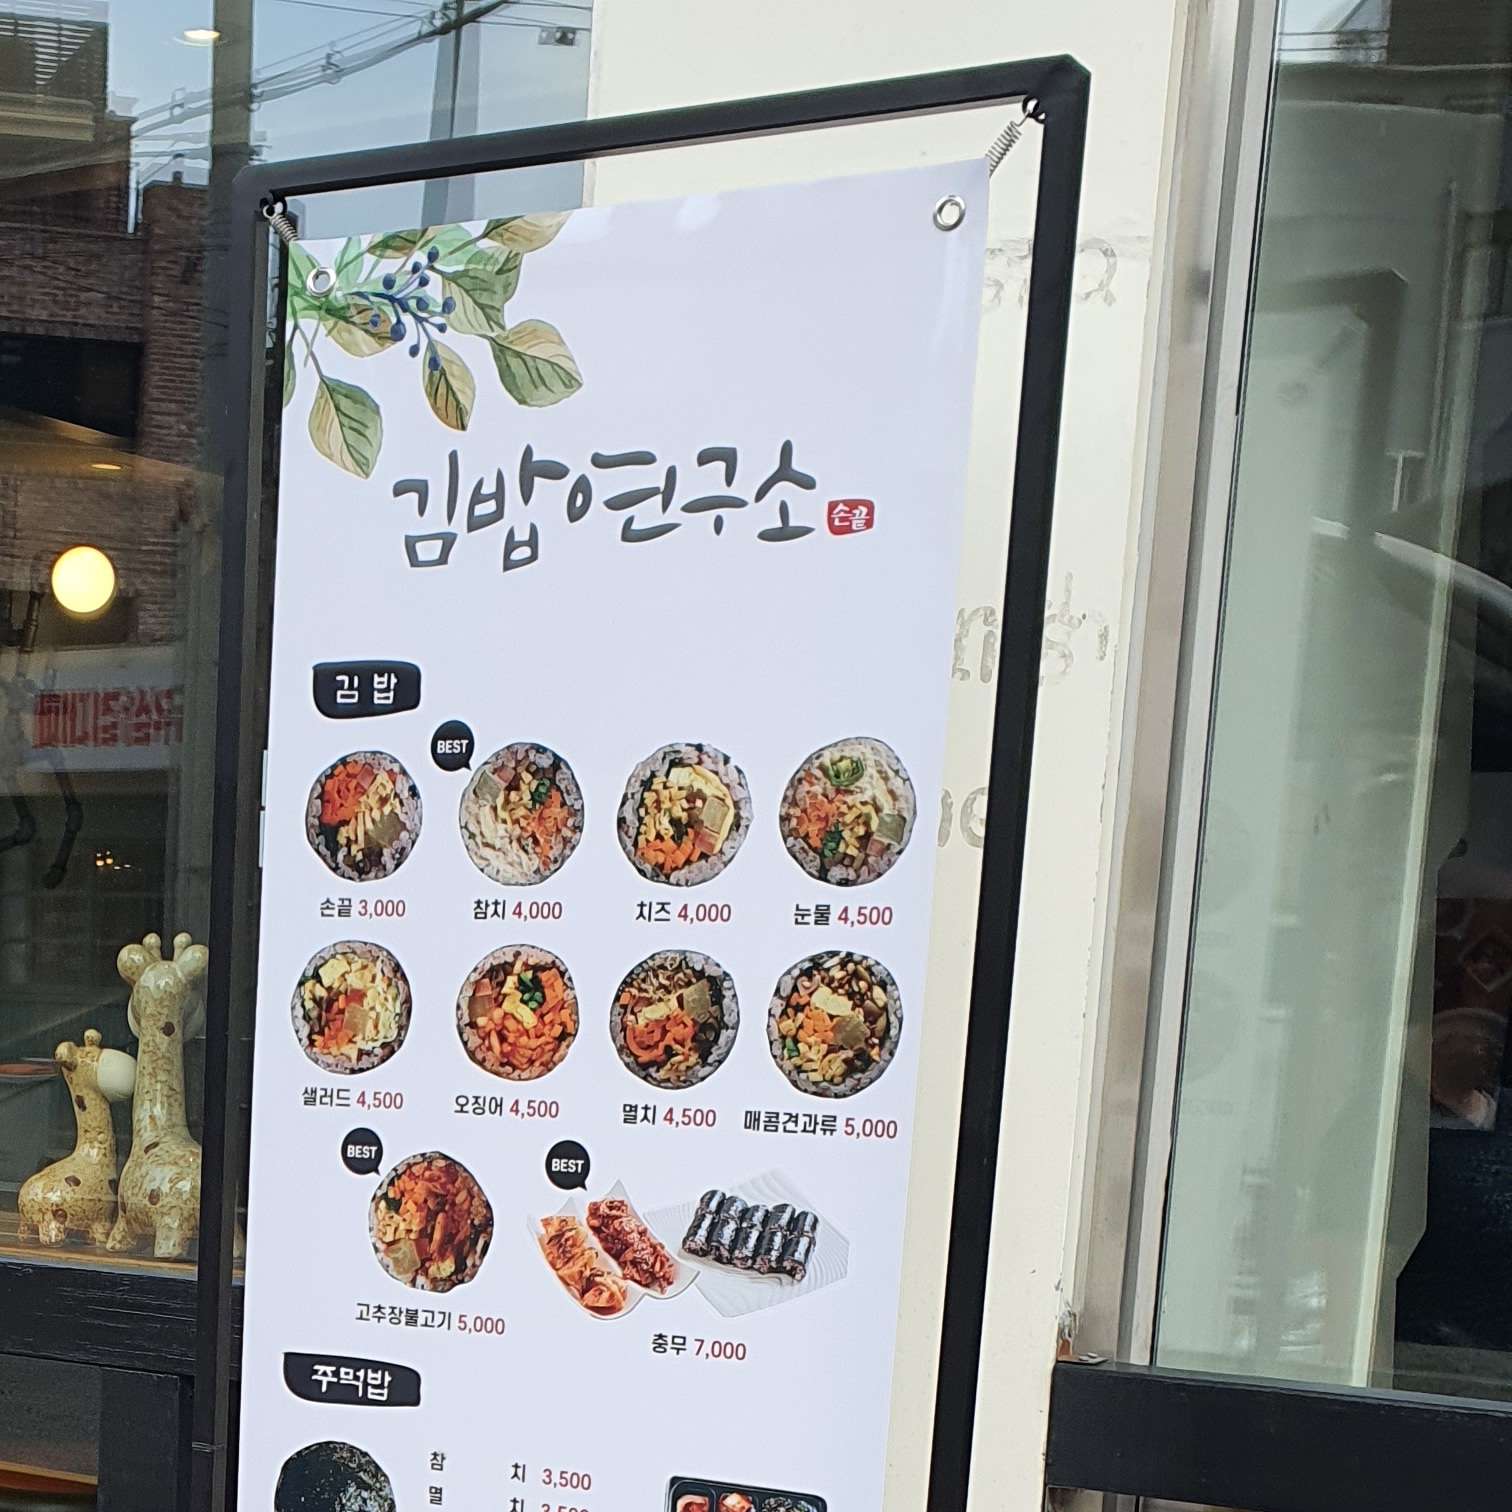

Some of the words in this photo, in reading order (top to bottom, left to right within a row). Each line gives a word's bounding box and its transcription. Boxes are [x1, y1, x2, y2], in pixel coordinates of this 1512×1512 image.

[392, 439, 817, 573] 김밥연구소
[830, 502, 871, 532] 손끝
[436, 739, 469, 754] BEST
[319, 897, 353, 918] 손끝
[357, 899, 406, 920] 3,000
[473, 898, 506, 920] 참치
[511, 901, 563, 922] 4,000
[635, 900, 671, 923] 치즈
[677, 903, 732, 925] 4,000
[793, 903, 832, 926] 눈물
[837, 905, 893, 928] 4,500
[302, 1086, 351, 1108] 샐러드
[356, 1090, 404, 1111] 4,500
[454, 1094, 504, 1117] 오징어
[509, 1098, 560, 1119] 4,500
[622, 1103, 657, 1126] 멸치
[662, 1106, 717, 1128] 4,500
[743, 1110, 838, 1137] 매콤견과류
[844, 1117, 898, 1140] 5,000
[346, 1144, 378, 1159] BEST
[551, 1158, 585, 1173] BEST
[355, 1302, 452, 1331] 고추장불고기
[457, 1314, 506, 1336] 5,000
[651, 1332, 687, 1356] 충무
[694, 1338, 747, 1361] 7,000
[310, 1364, 393, 1402] 주먹밥
[541, 1468, 592, 1491] 3,500
